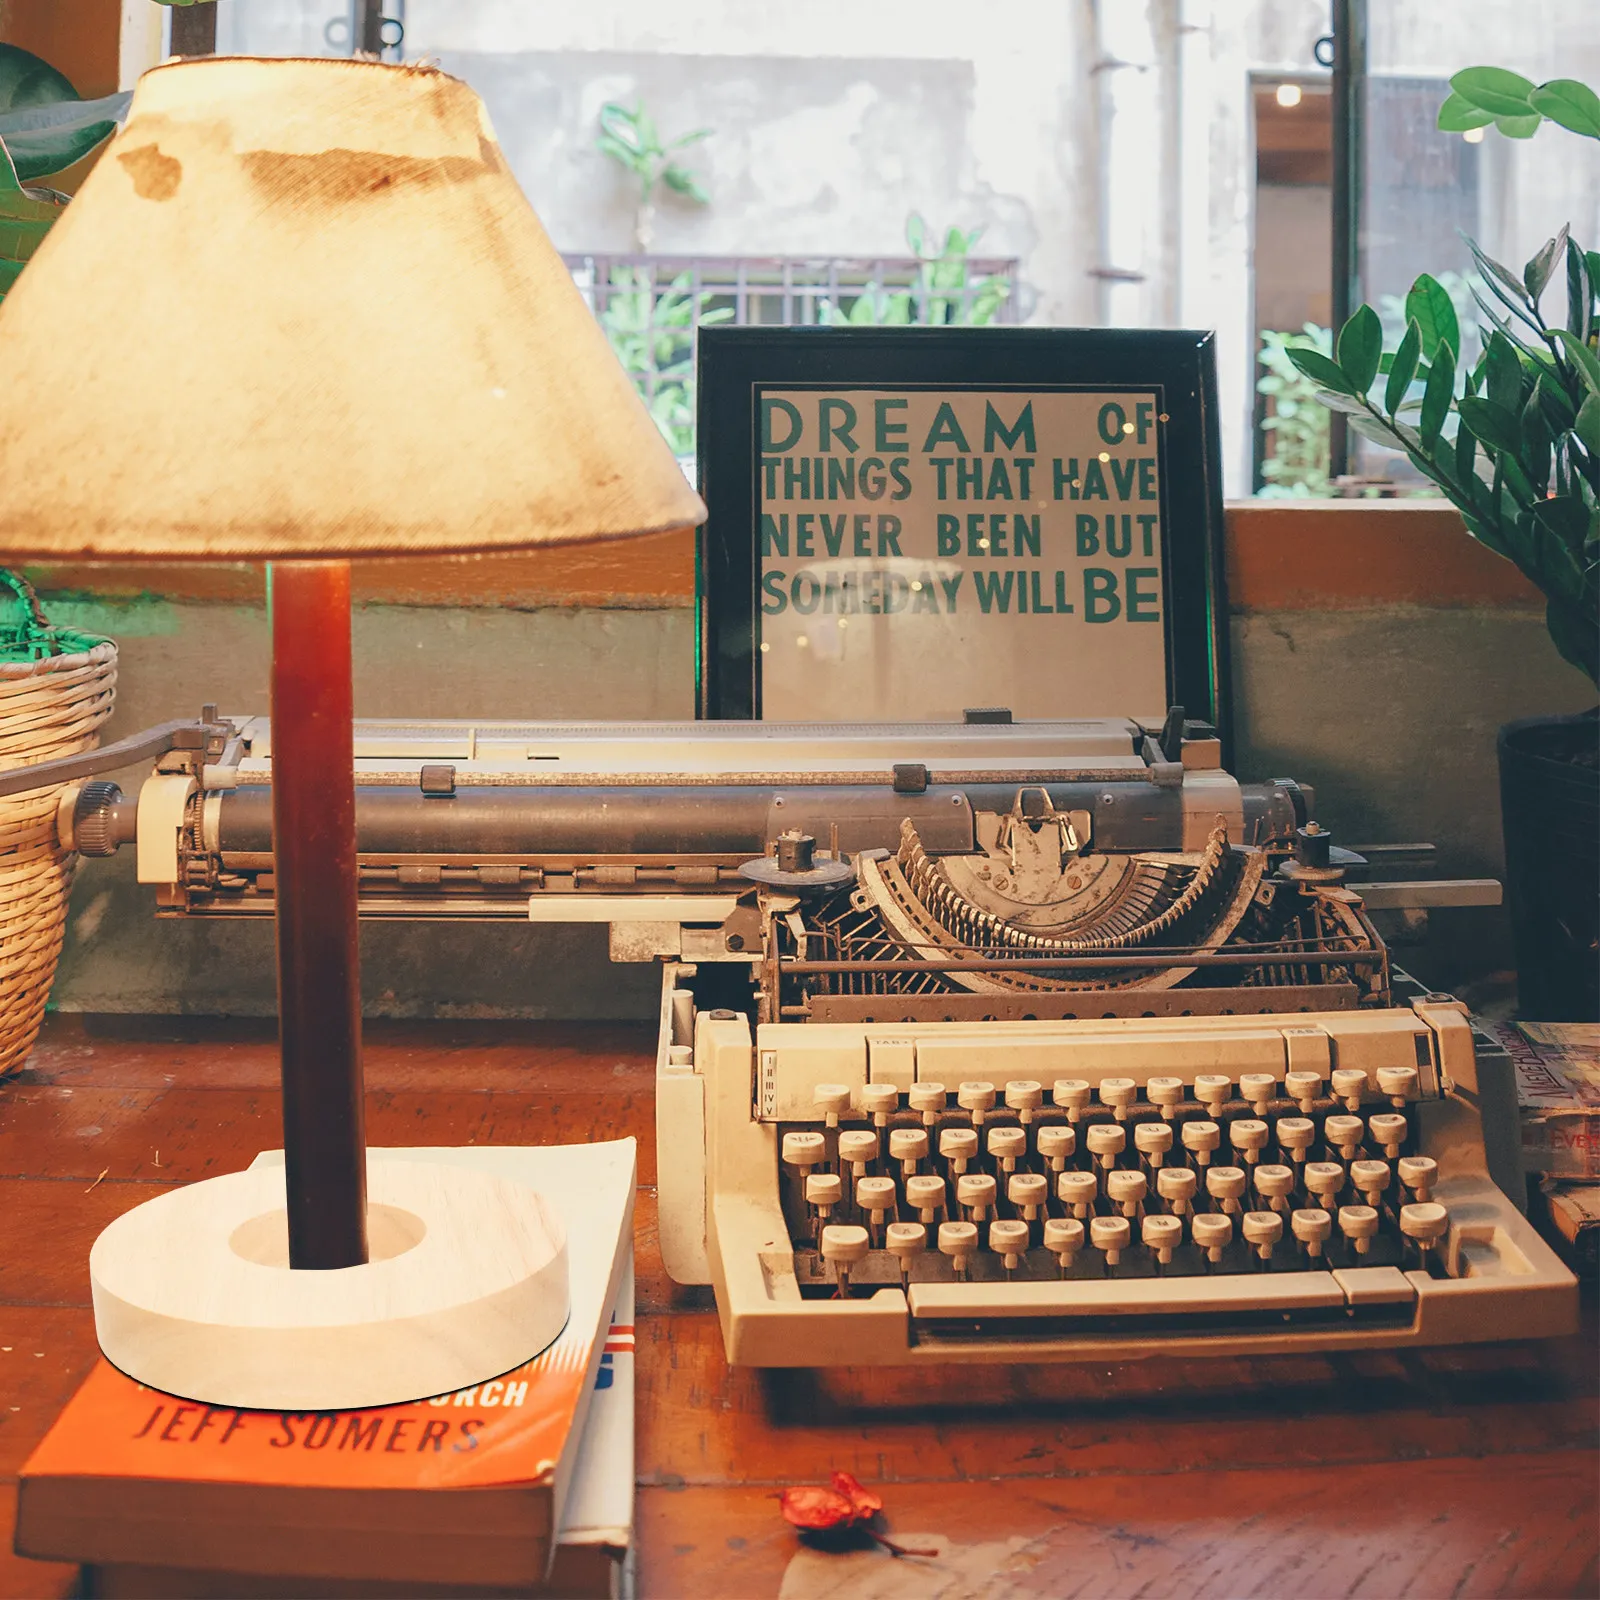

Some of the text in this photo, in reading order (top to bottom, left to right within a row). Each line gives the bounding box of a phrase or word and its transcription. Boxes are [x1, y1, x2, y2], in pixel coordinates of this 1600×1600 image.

[761, 398, 1154, 453] DREAM OF
[761, 457, 1156, 501] THINGS THAT HAVE
[761, 514, 1157, 557] NEVER BEEN BUT
[761, 567, 1160, 623] SOMEDAY WILL BE
[133, 1405, 486, 1453] JEFF SOMERS
